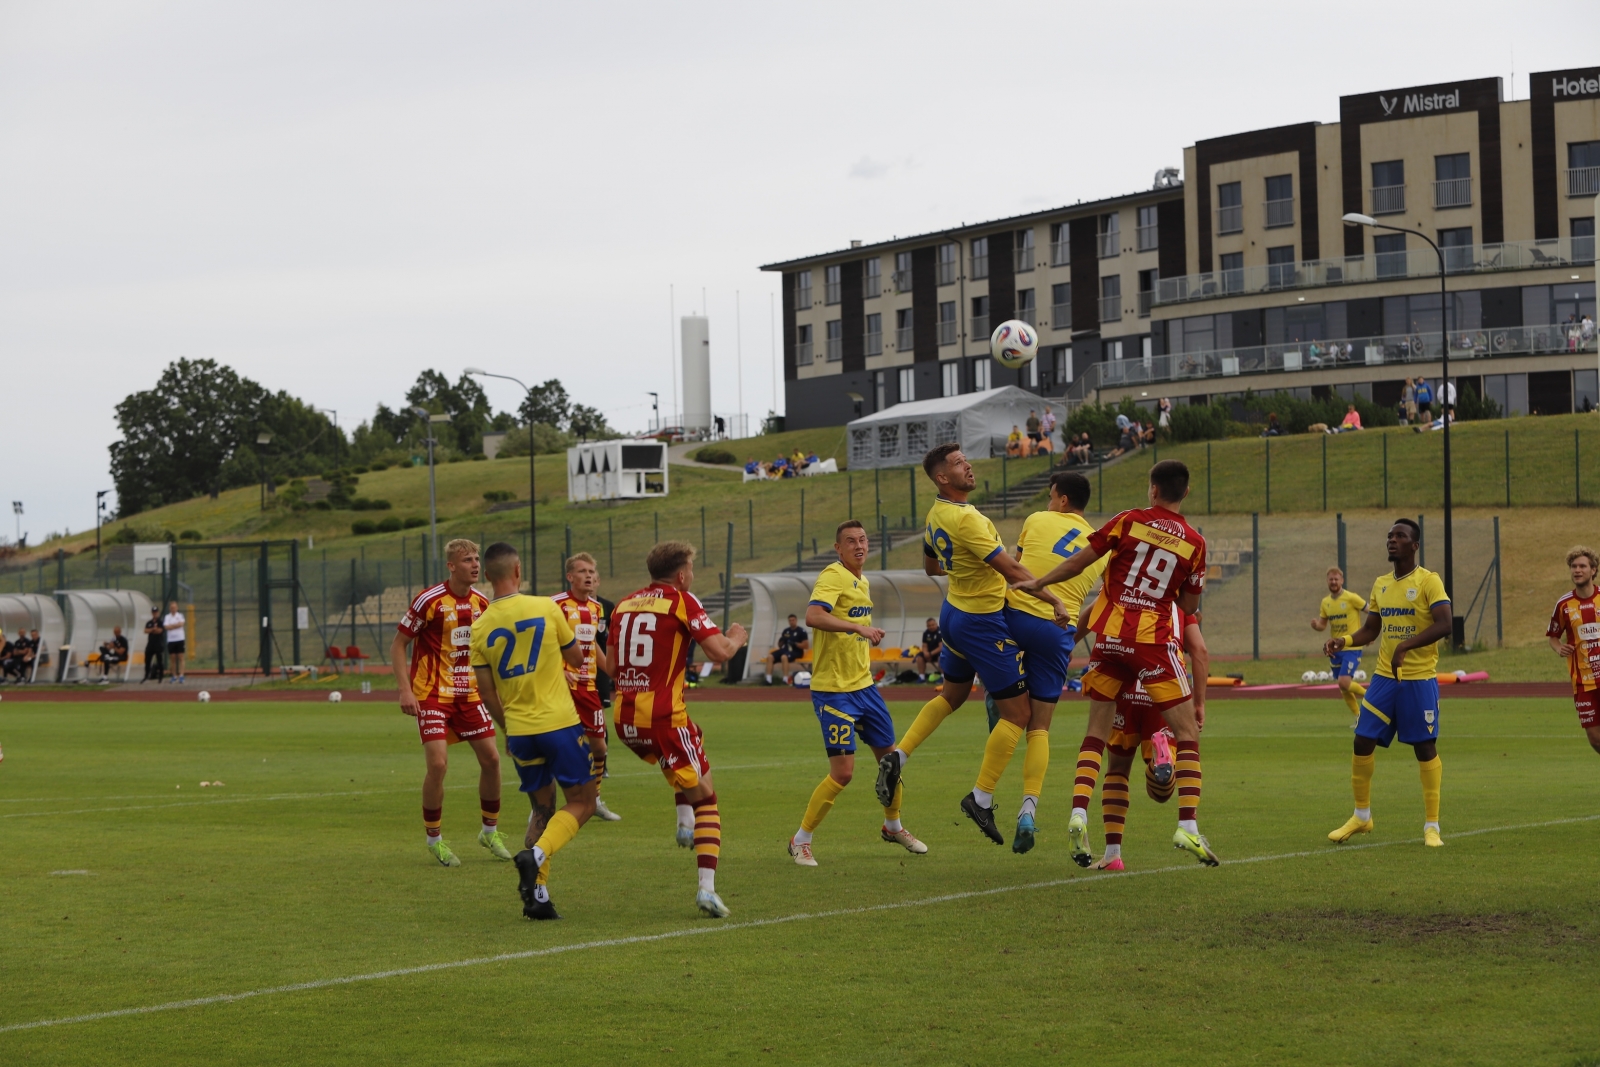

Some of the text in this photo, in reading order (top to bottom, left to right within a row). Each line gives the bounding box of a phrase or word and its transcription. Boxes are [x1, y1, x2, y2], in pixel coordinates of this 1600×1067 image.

[1552, 73, 1600, 97] Hotel
[1403, 89, 1460, 114] Mistral
[1122, 541, 1179, 600] 19
[1119, 594, 1157, 608] URBANIAK
[453, 630, 471, 640] Skib
[618, 612, 657, 667] 16
[1388, 624, 1416, 634] Energa
[487, 617, 545, 679] 27
[1105, 643, 1135, 655] MODULAR
[593, 710, 604, 726] 18
[828, 724, 851, 745] 32
